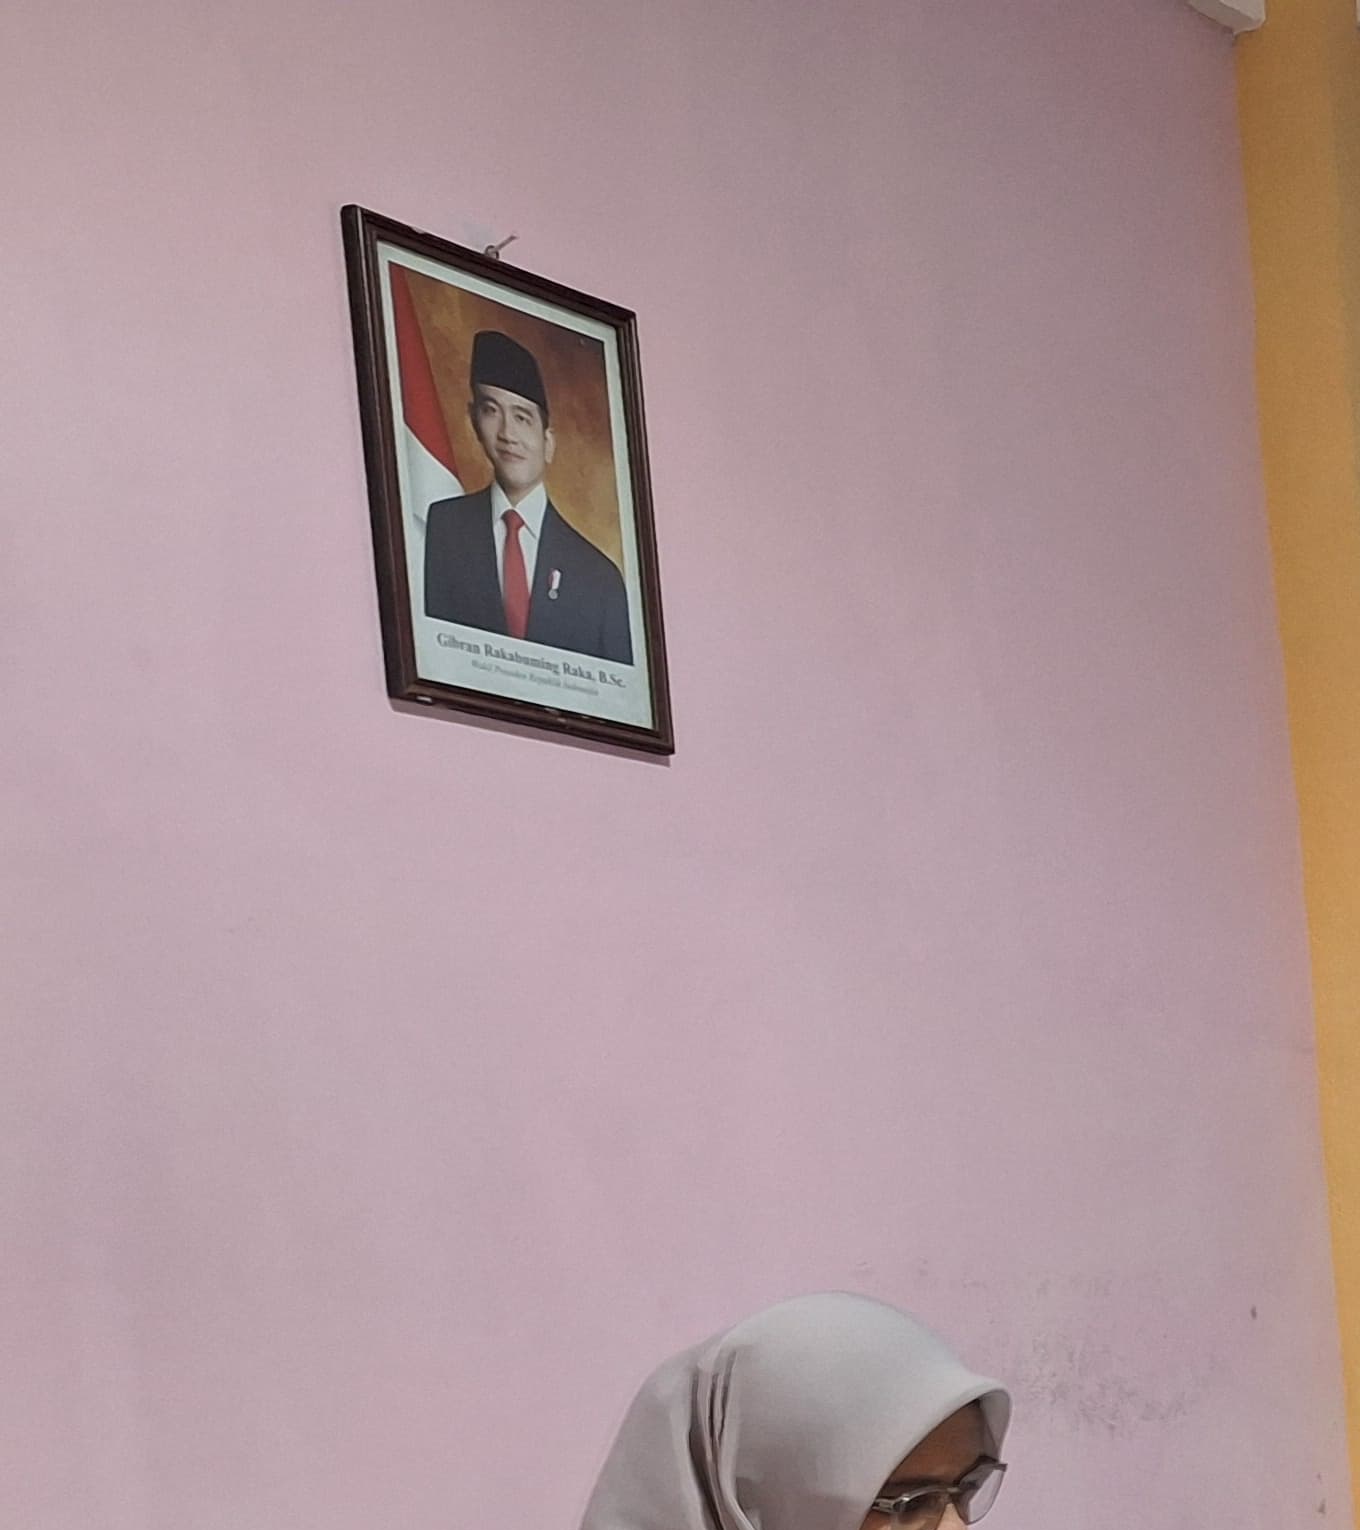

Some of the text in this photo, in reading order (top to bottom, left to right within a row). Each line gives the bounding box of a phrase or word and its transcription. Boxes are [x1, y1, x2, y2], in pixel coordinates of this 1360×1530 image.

[436, 633, 480, 654] Gibran
[484, 643, 559, 676] Rakabuming
[599, 670, 626, 689] B.Sc.
